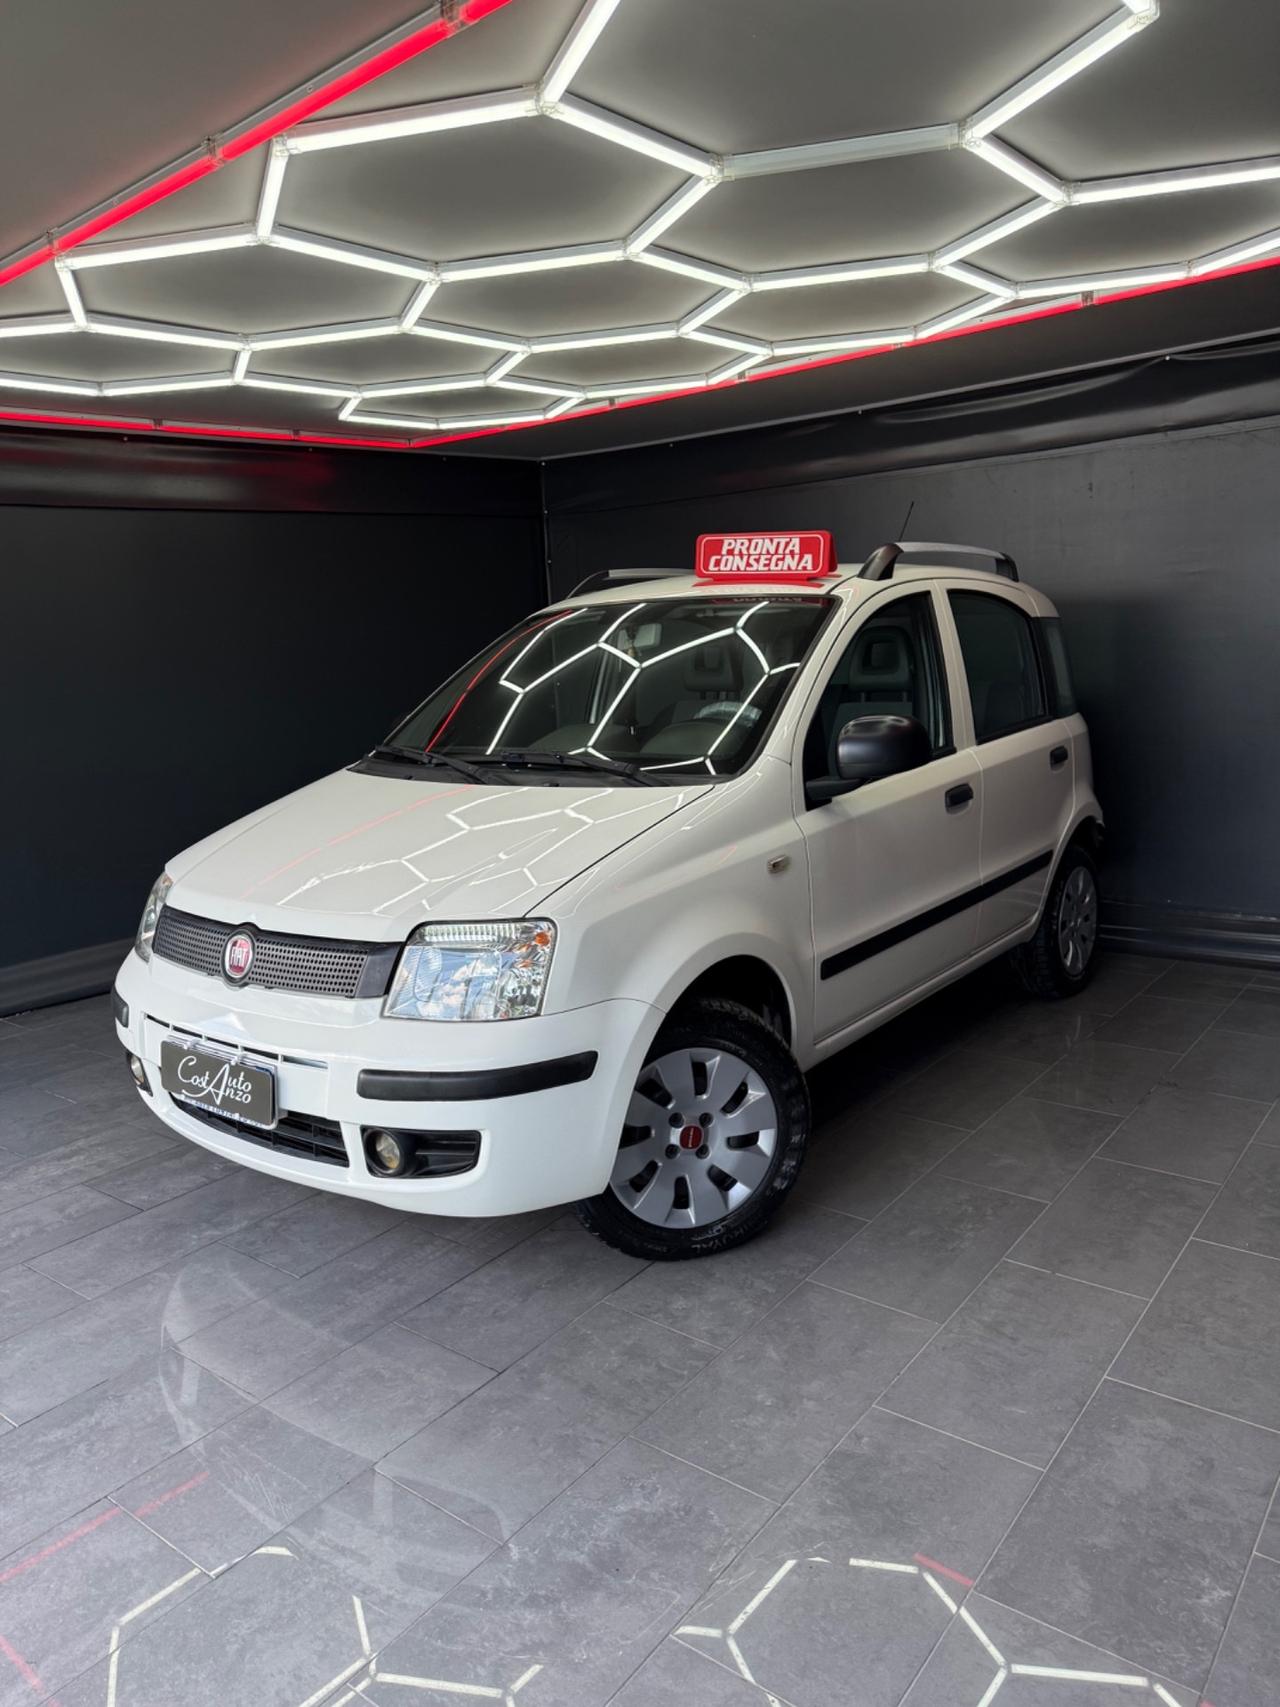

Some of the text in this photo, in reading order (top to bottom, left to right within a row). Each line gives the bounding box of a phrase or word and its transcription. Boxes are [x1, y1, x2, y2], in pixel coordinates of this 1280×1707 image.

[721, 537, 800, 555] PRONTA
[708, 554, 813, 571] CONSEGNA
[231, 946, 249, 967] FIAT
